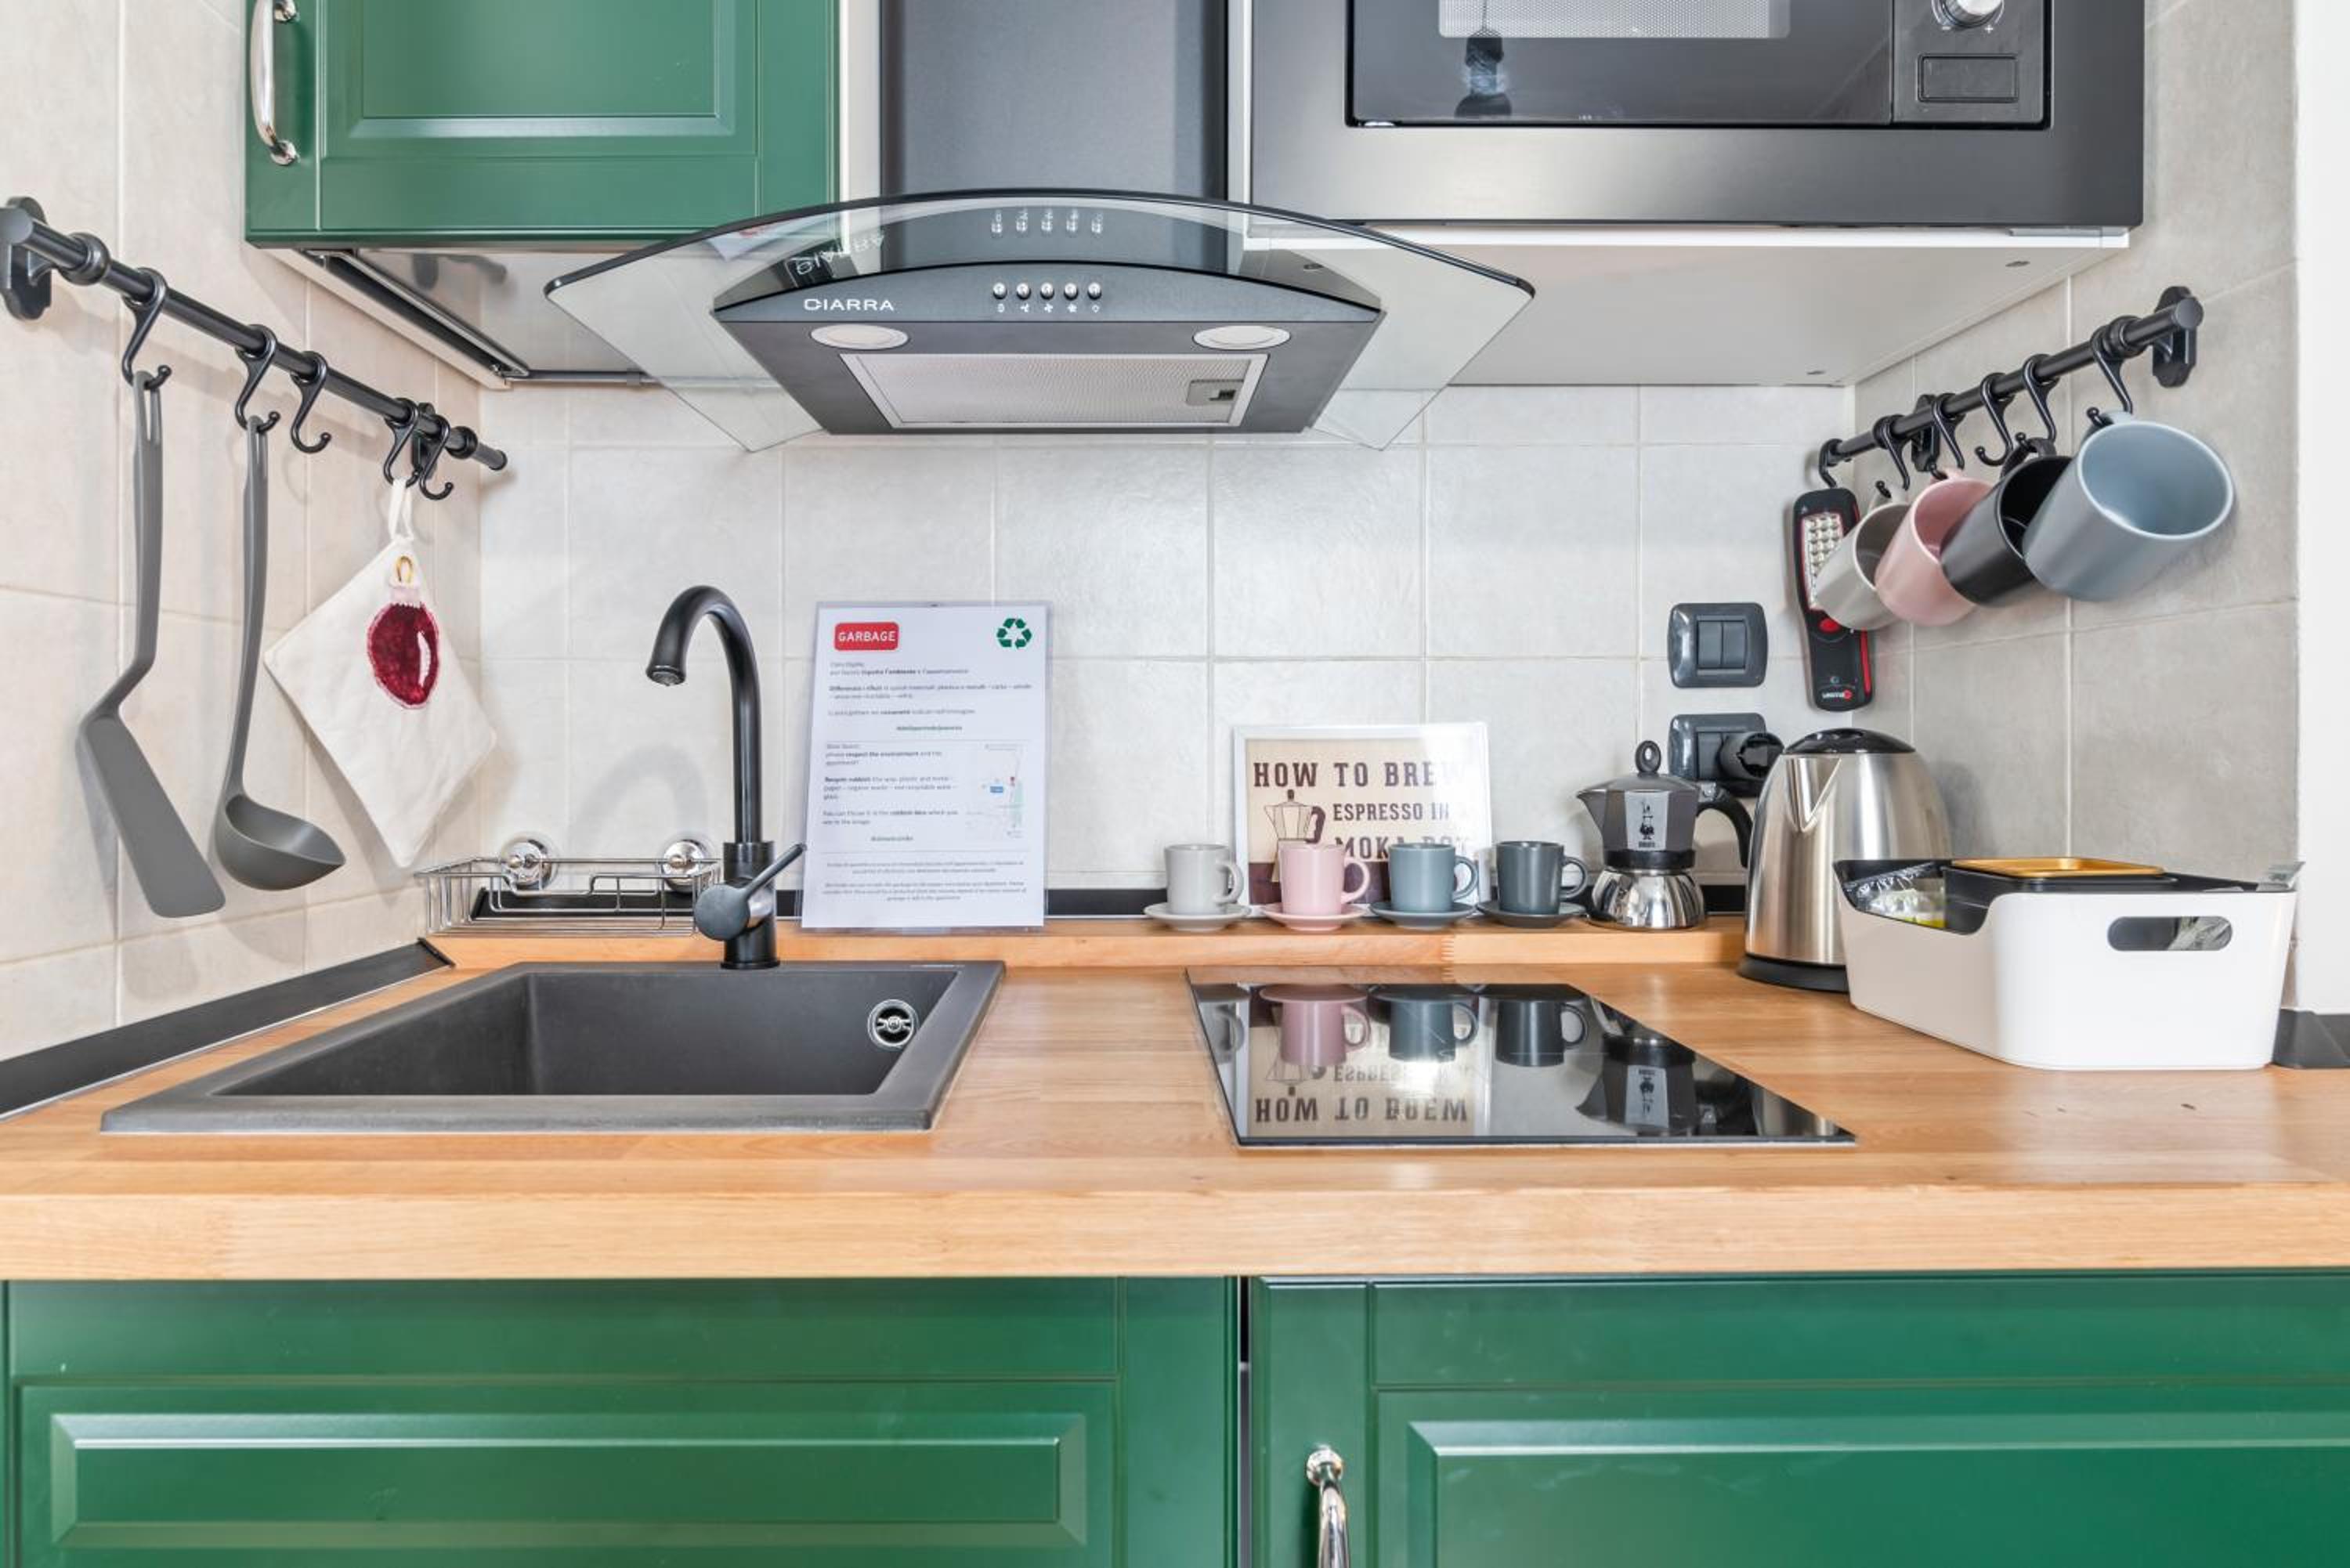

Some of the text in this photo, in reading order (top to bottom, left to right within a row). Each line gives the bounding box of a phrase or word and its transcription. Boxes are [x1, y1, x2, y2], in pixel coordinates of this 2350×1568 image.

[804, 298, 895, 312] CIARRA
[838, 630, 896, 642] GARBAGE
[1253, 762, 1441, 787] HOW TO BRE
[1333, 803, 1423, 821] ESPRESSO
[1336, 836, 1405, 859] MOK
